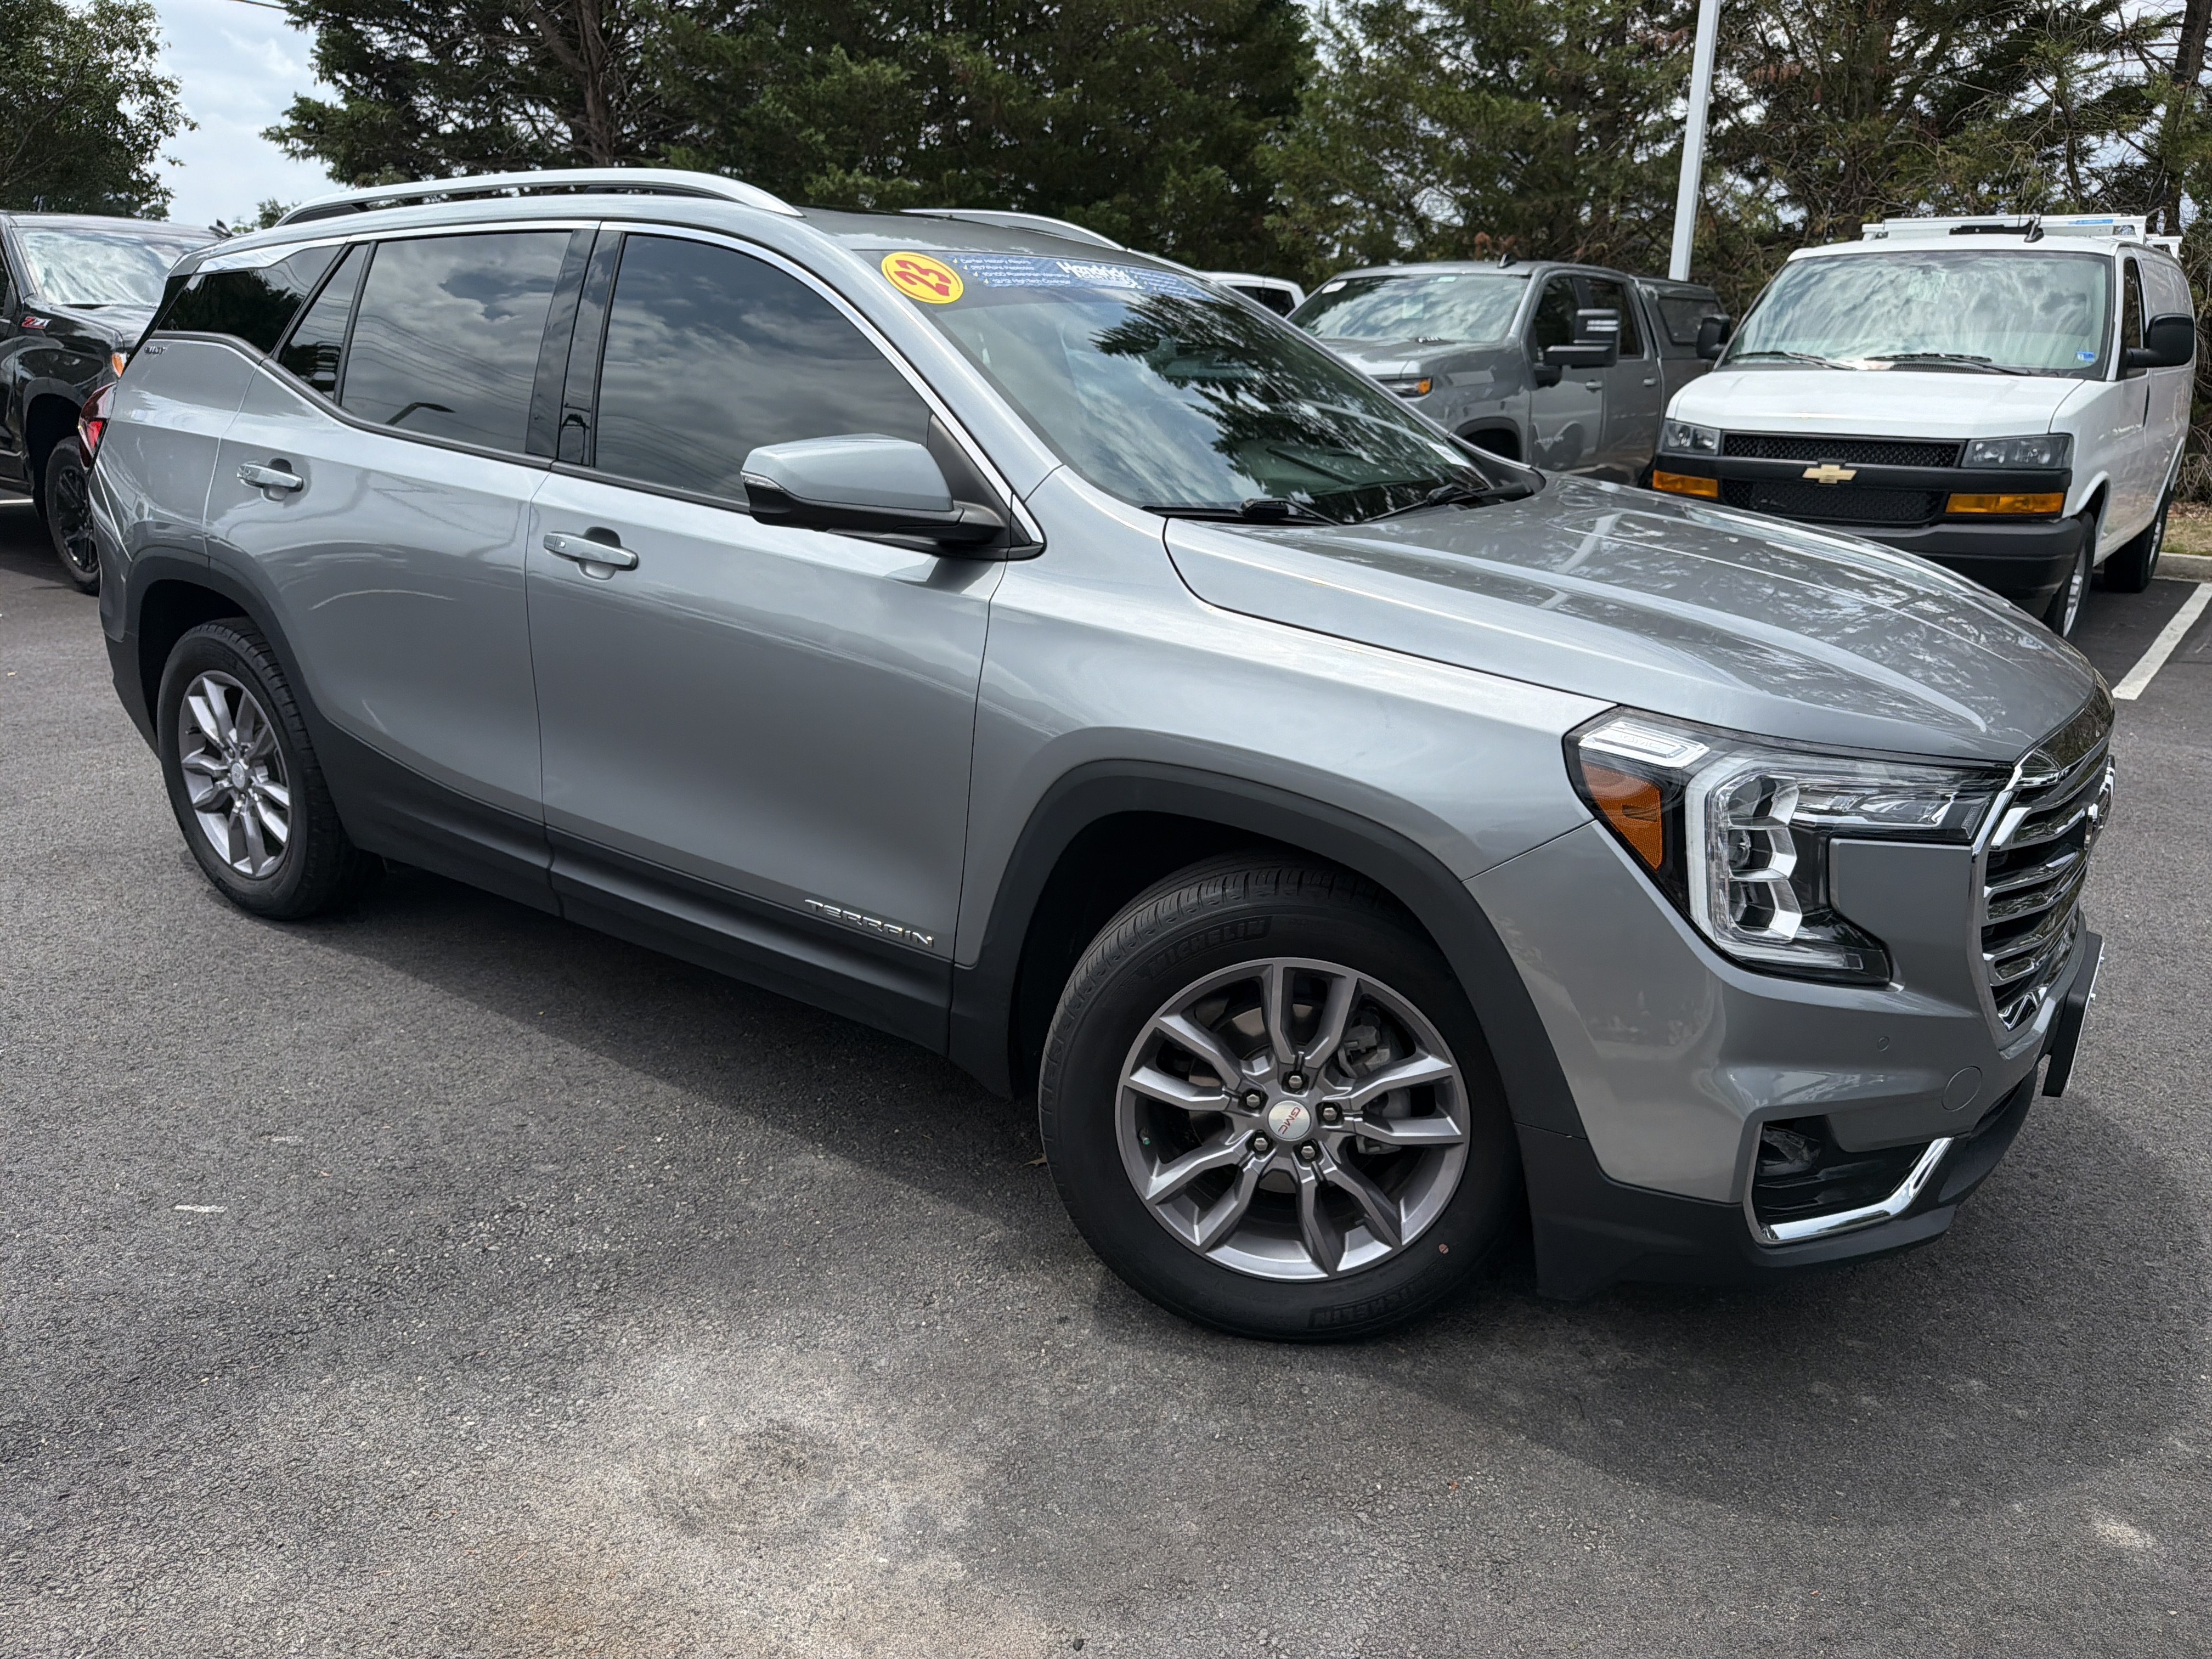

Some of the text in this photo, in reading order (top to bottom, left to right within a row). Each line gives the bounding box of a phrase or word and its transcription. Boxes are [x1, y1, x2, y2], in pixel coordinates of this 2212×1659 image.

[894, 259, 952, 297] 23
[1056, 261, 1129, 279] Hendrick
[21, 316, 52, 329] Z71
[805, 899, 934, 948] TERRAIN
[1148, 919, 1266, 979] MICHELIN
[1277, 1106, 1301, 1135] GMC
